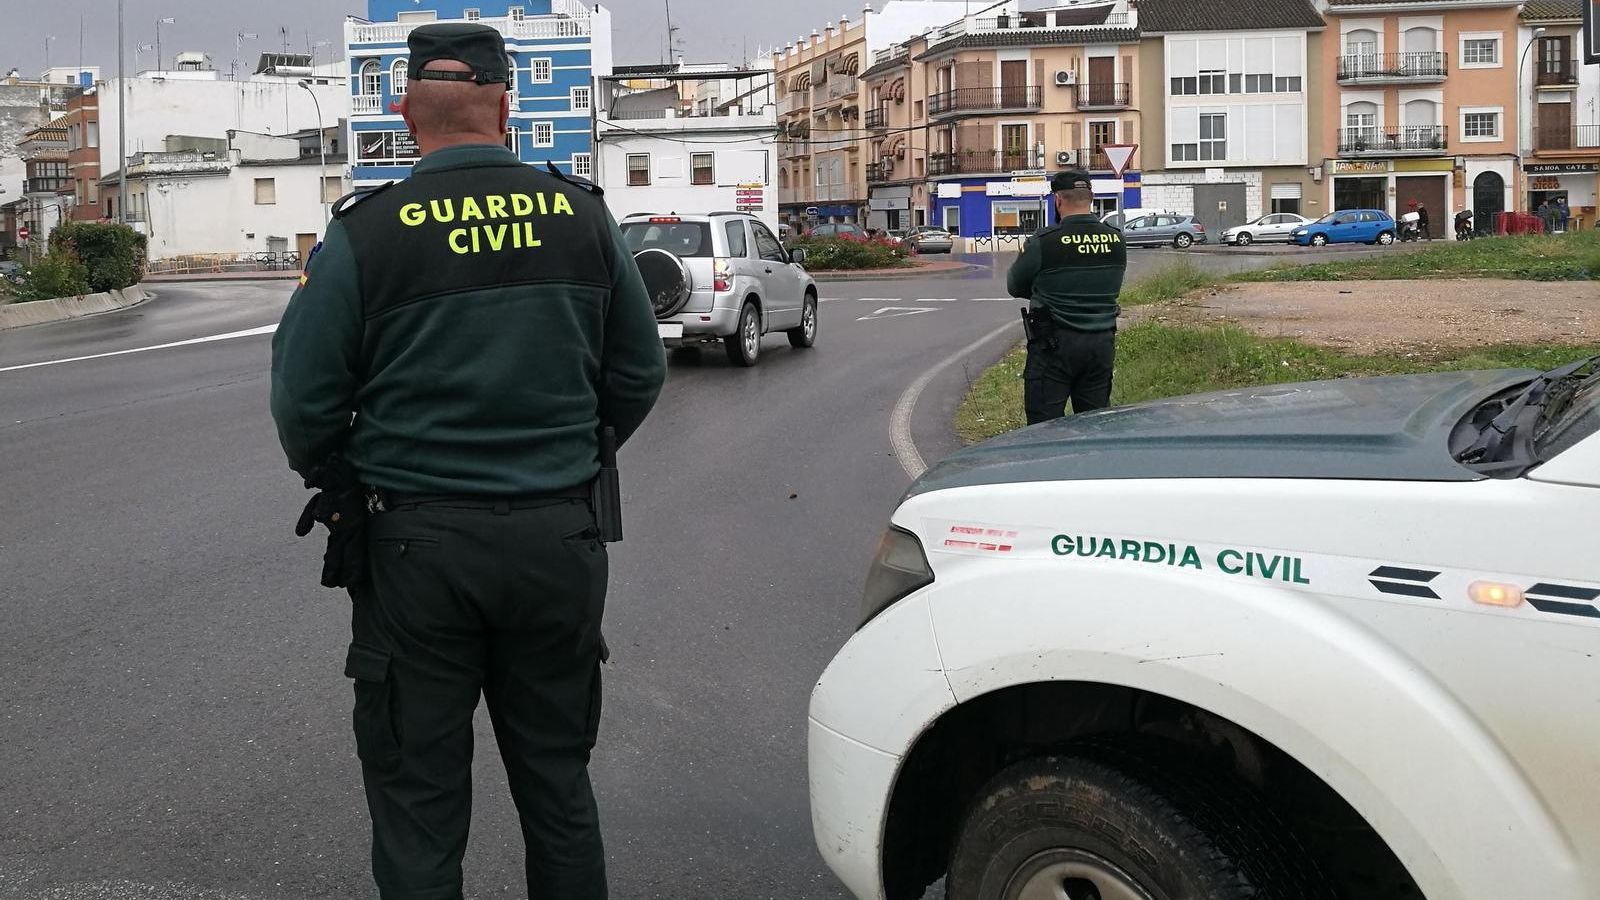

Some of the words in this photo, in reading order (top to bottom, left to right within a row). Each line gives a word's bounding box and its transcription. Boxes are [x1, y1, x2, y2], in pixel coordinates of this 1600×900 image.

[399, 192, 575, 227] GUARDIA
[448, 222, 542, 254] CIVIL
[1061, 233, 1121, 244] GUARDIA
[1077, 243, 1112, 254] CIVIL
[1050, 534, 1203, 570] GUARDIA
[1216, 549, 1310, 585] CIVIL
